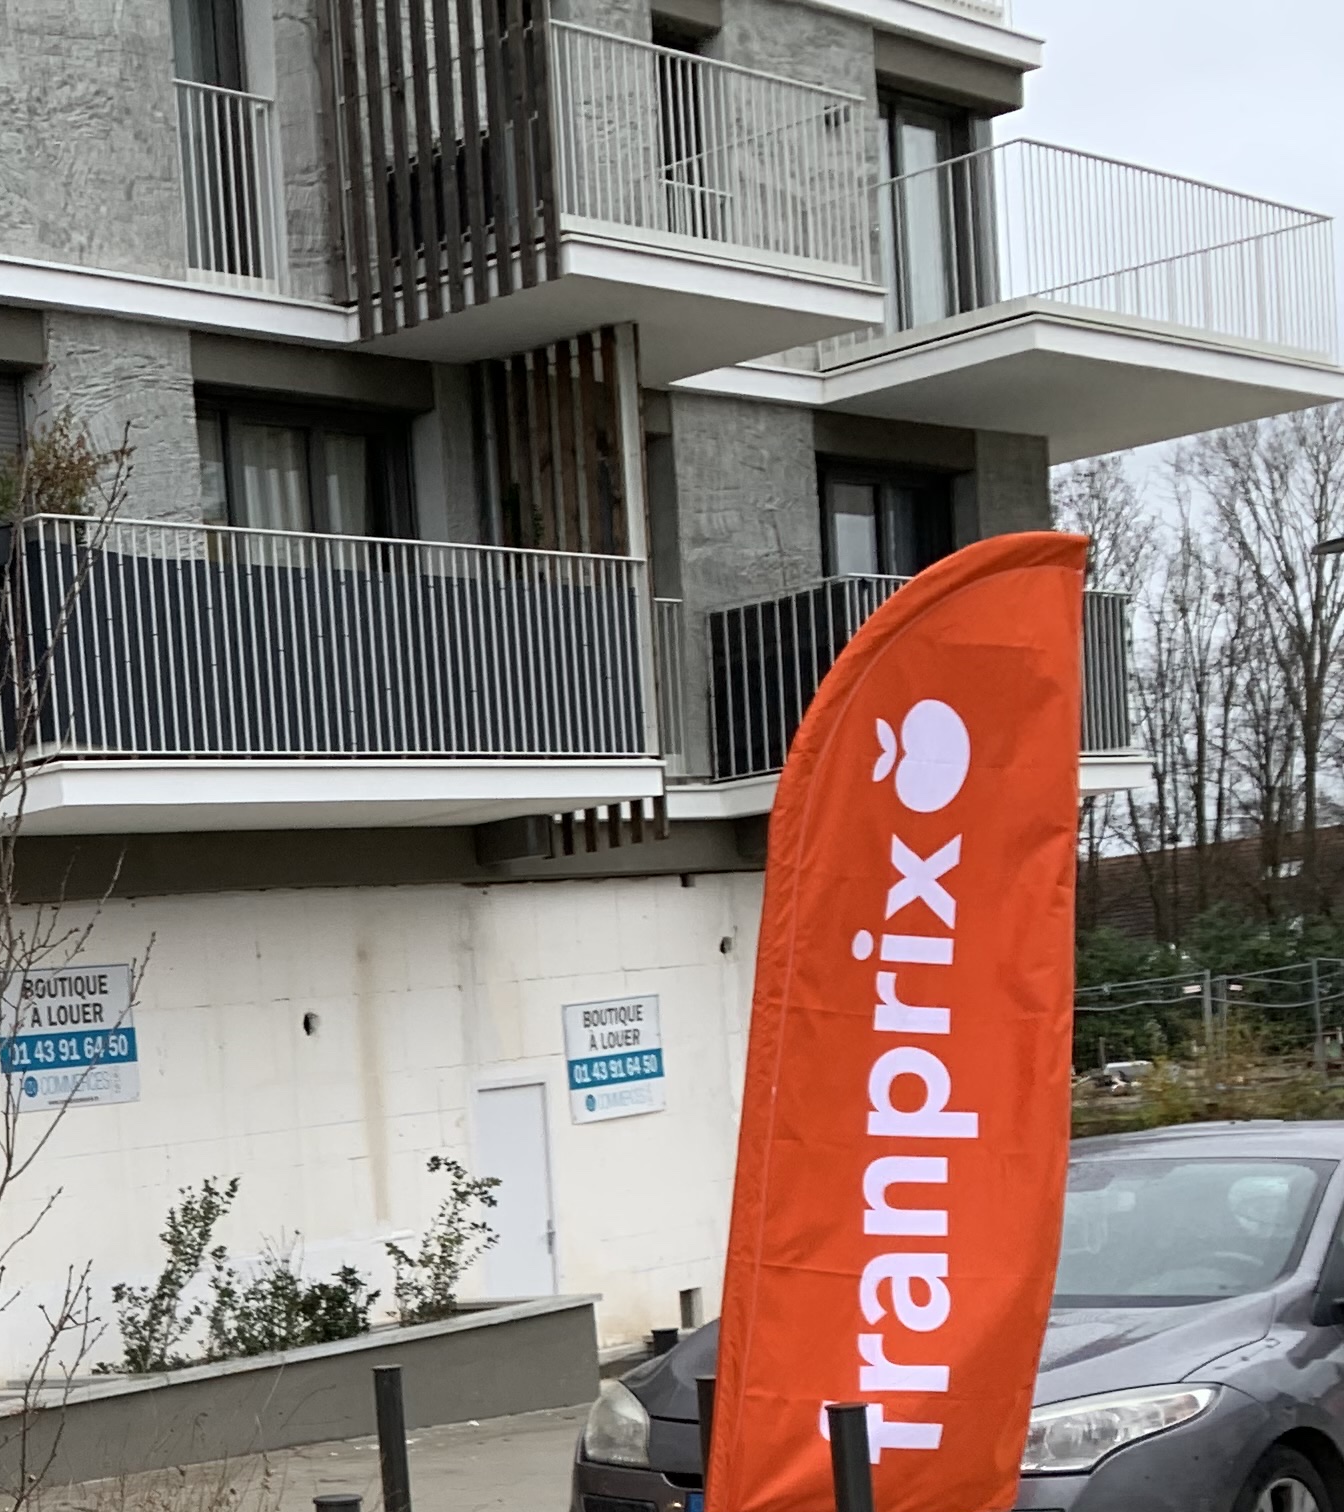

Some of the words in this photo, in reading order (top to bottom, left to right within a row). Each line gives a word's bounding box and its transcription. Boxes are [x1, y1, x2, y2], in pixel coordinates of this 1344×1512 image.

[23, 974, 109, 1000] BOUTIQUE
[47, 1003, 104, 1027] LOUER
[583, 1004, 643, 1028] BOUTIQUE
[11, 1042, 31, 1066] 01
[35, 1040, 56, 1063] 43
[59, 1038, 81, 1061] 91
[83, 1036, 106, 1059] 64
[108, 1033, 129, 1056] 50
[600, 1028, 641, 1050] LOUER
[592, 1061, 609, 1081] 43
[818, 833, 979, 1465] franprix
